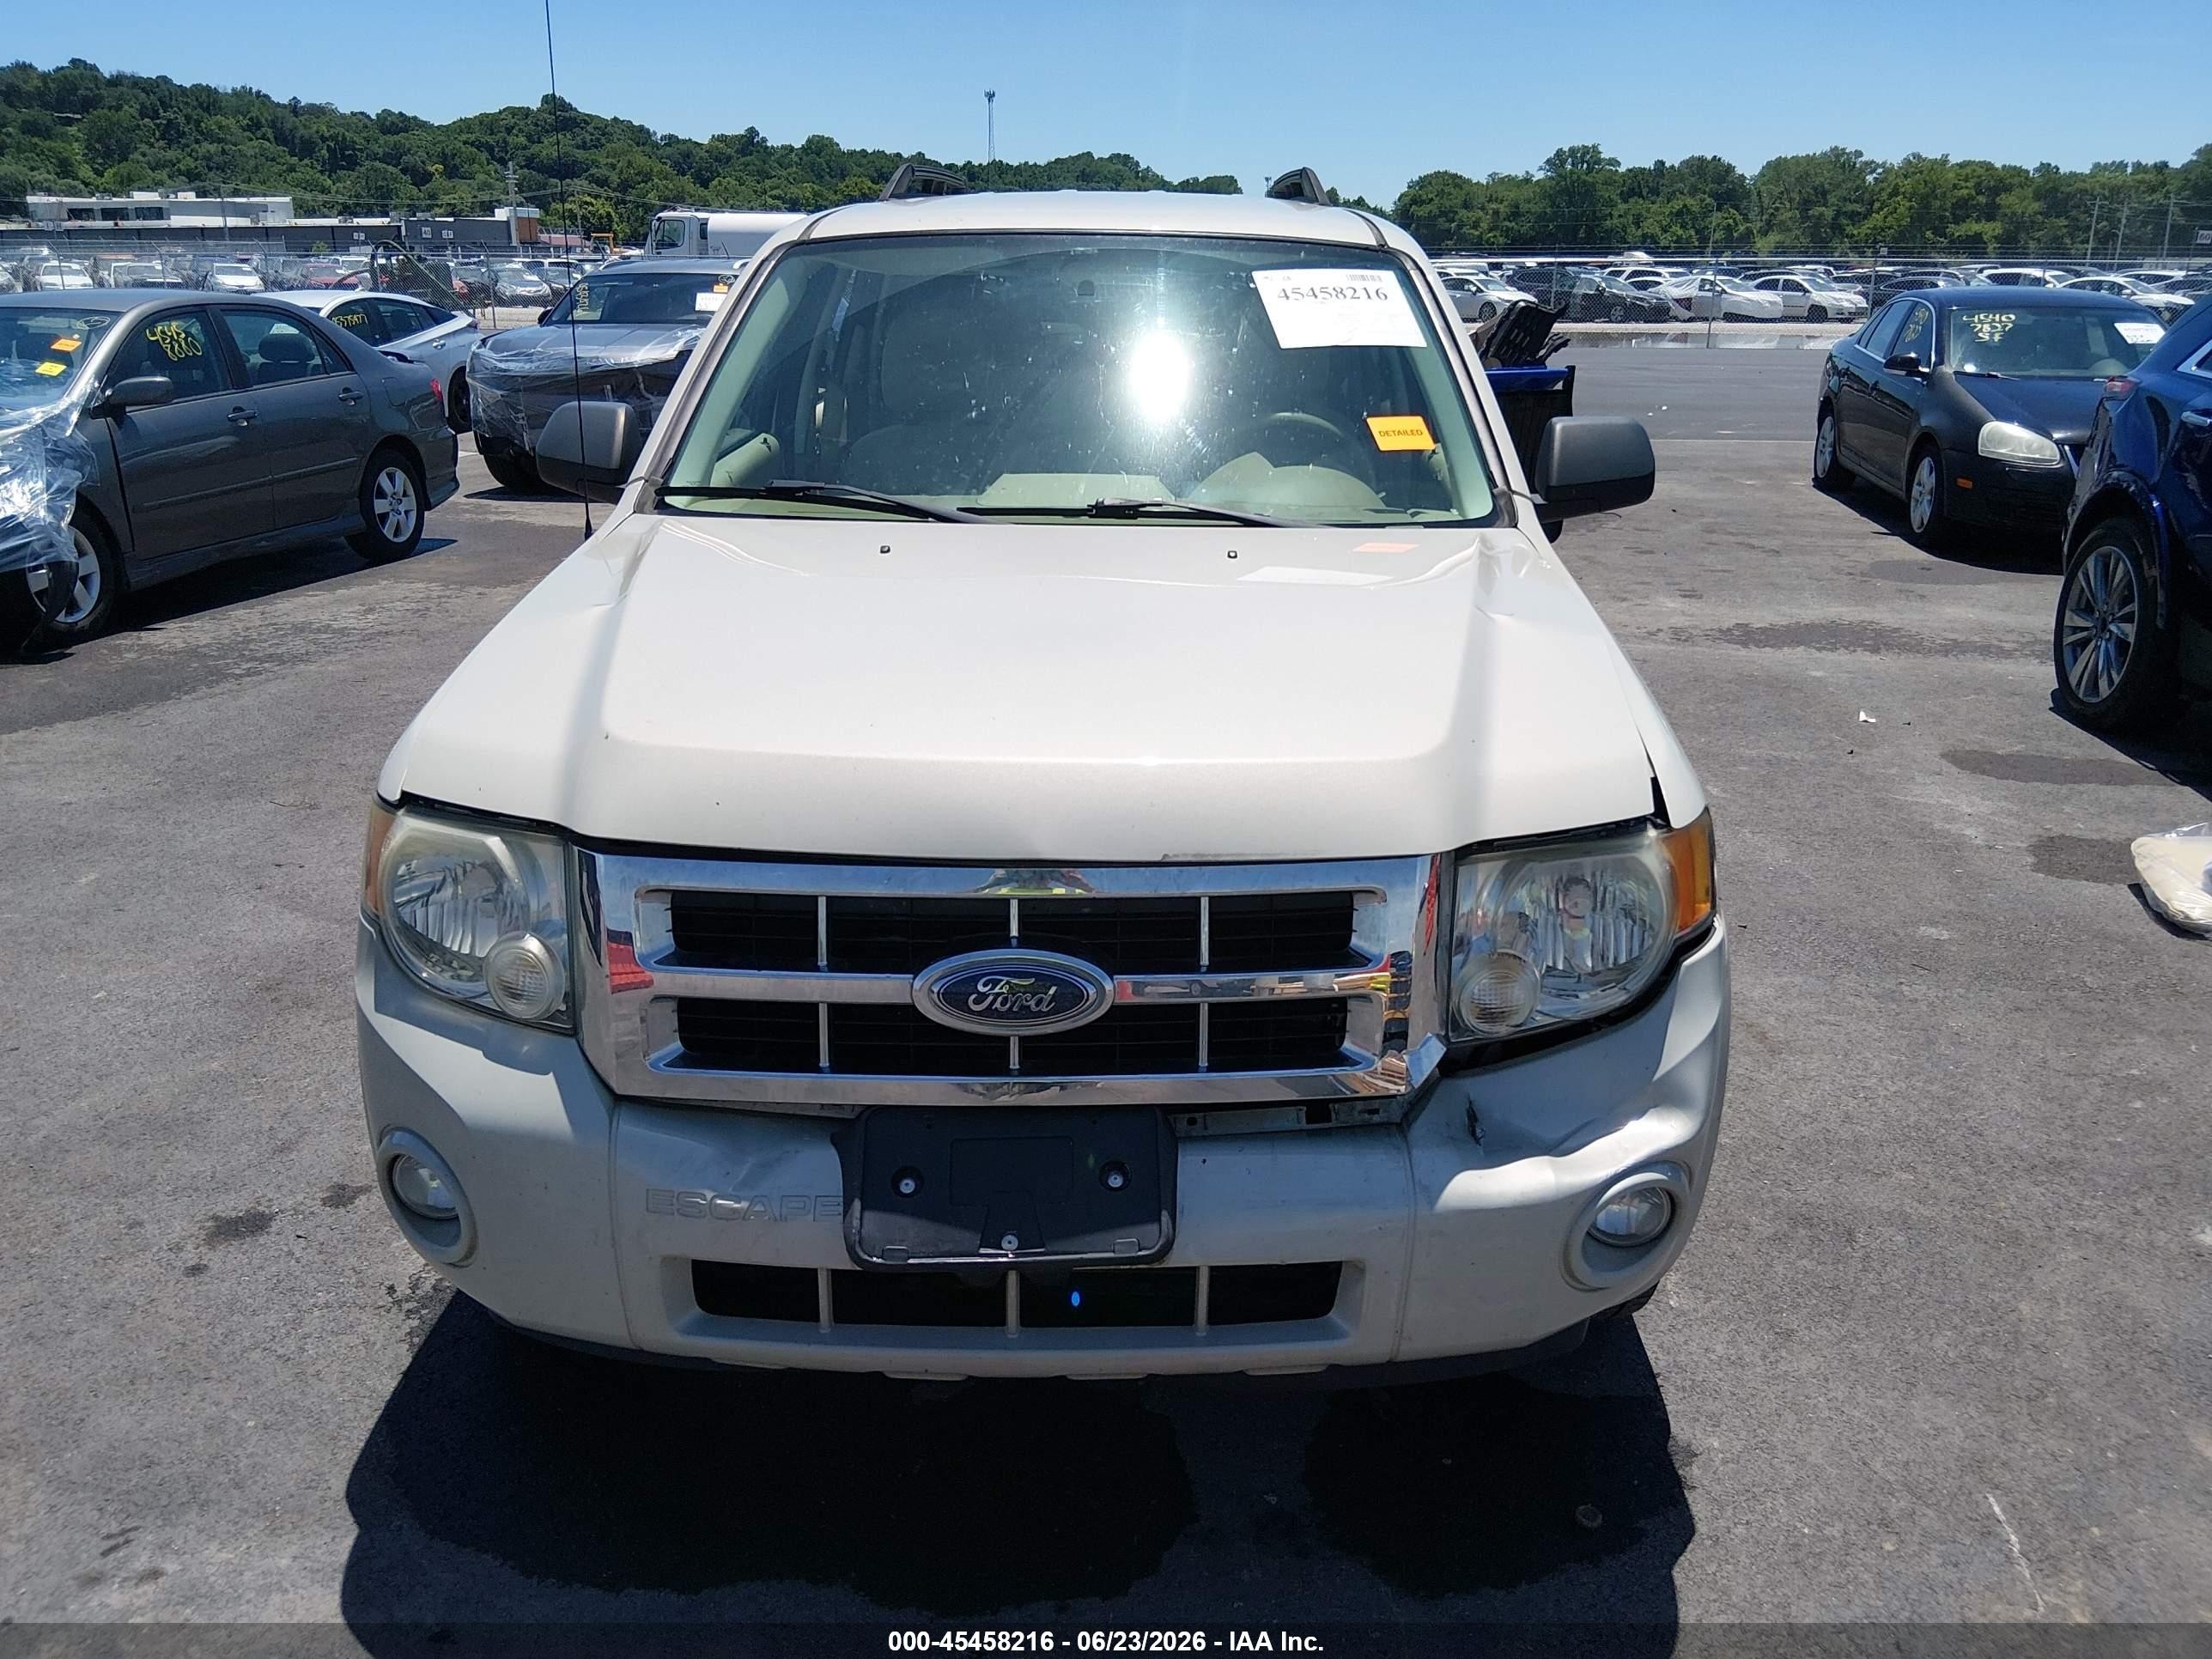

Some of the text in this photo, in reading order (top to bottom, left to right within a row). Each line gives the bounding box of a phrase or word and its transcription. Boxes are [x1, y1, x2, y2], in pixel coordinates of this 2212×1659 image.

[1277, 286, 1389, 301] 45458216
[968, 975, 1058, 1012] Ford
[646, 1188, 843, 1223] ESCAPE
